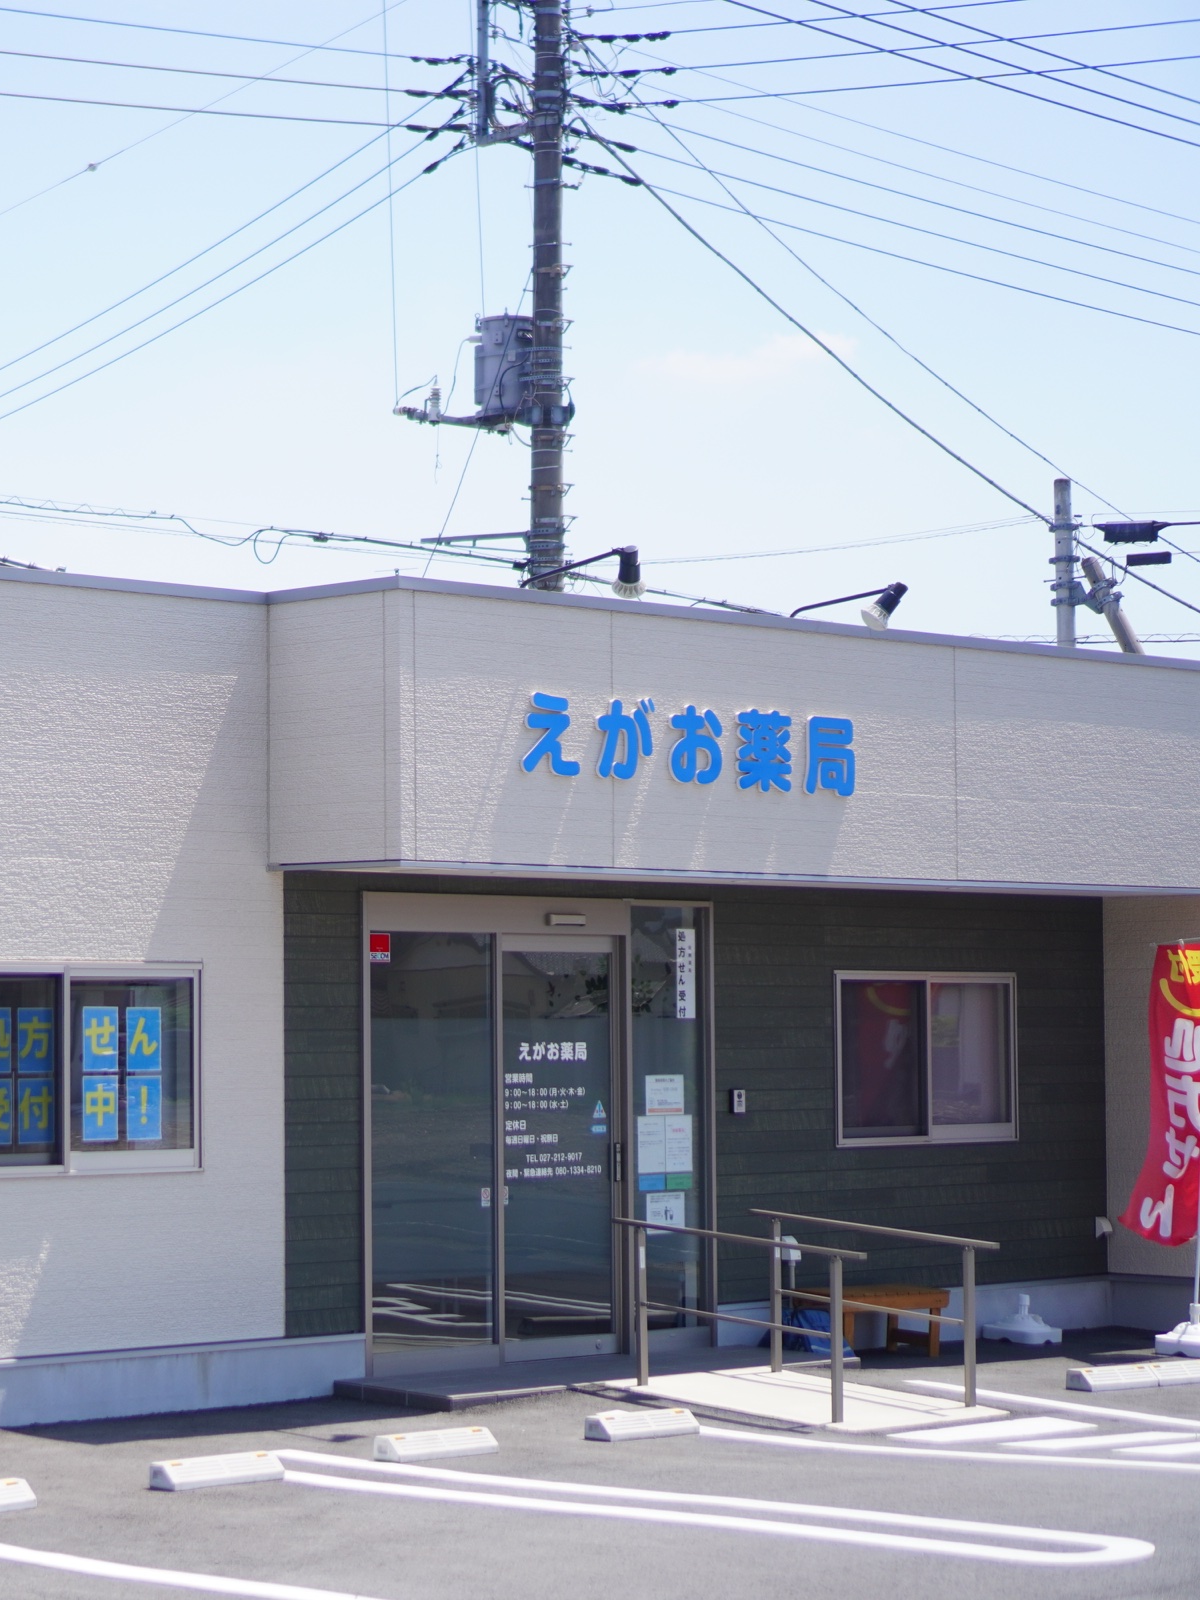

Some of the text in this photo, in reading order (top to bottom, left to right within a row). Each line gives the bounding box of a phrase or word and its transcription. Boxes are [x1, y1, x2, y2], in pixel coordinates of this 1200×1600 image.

[520, 691, 856, 796] えがお薬局
[678, 931, 686, 1018] 処方せん受付
[519, 1042, 587, 1060] えがお薬局
[505, 1073, 533, 1083] 営業時間
[505, 1120, 526, 1130] 定休日
[526, 1152, 583, 1163] TEL 027-212-9017
